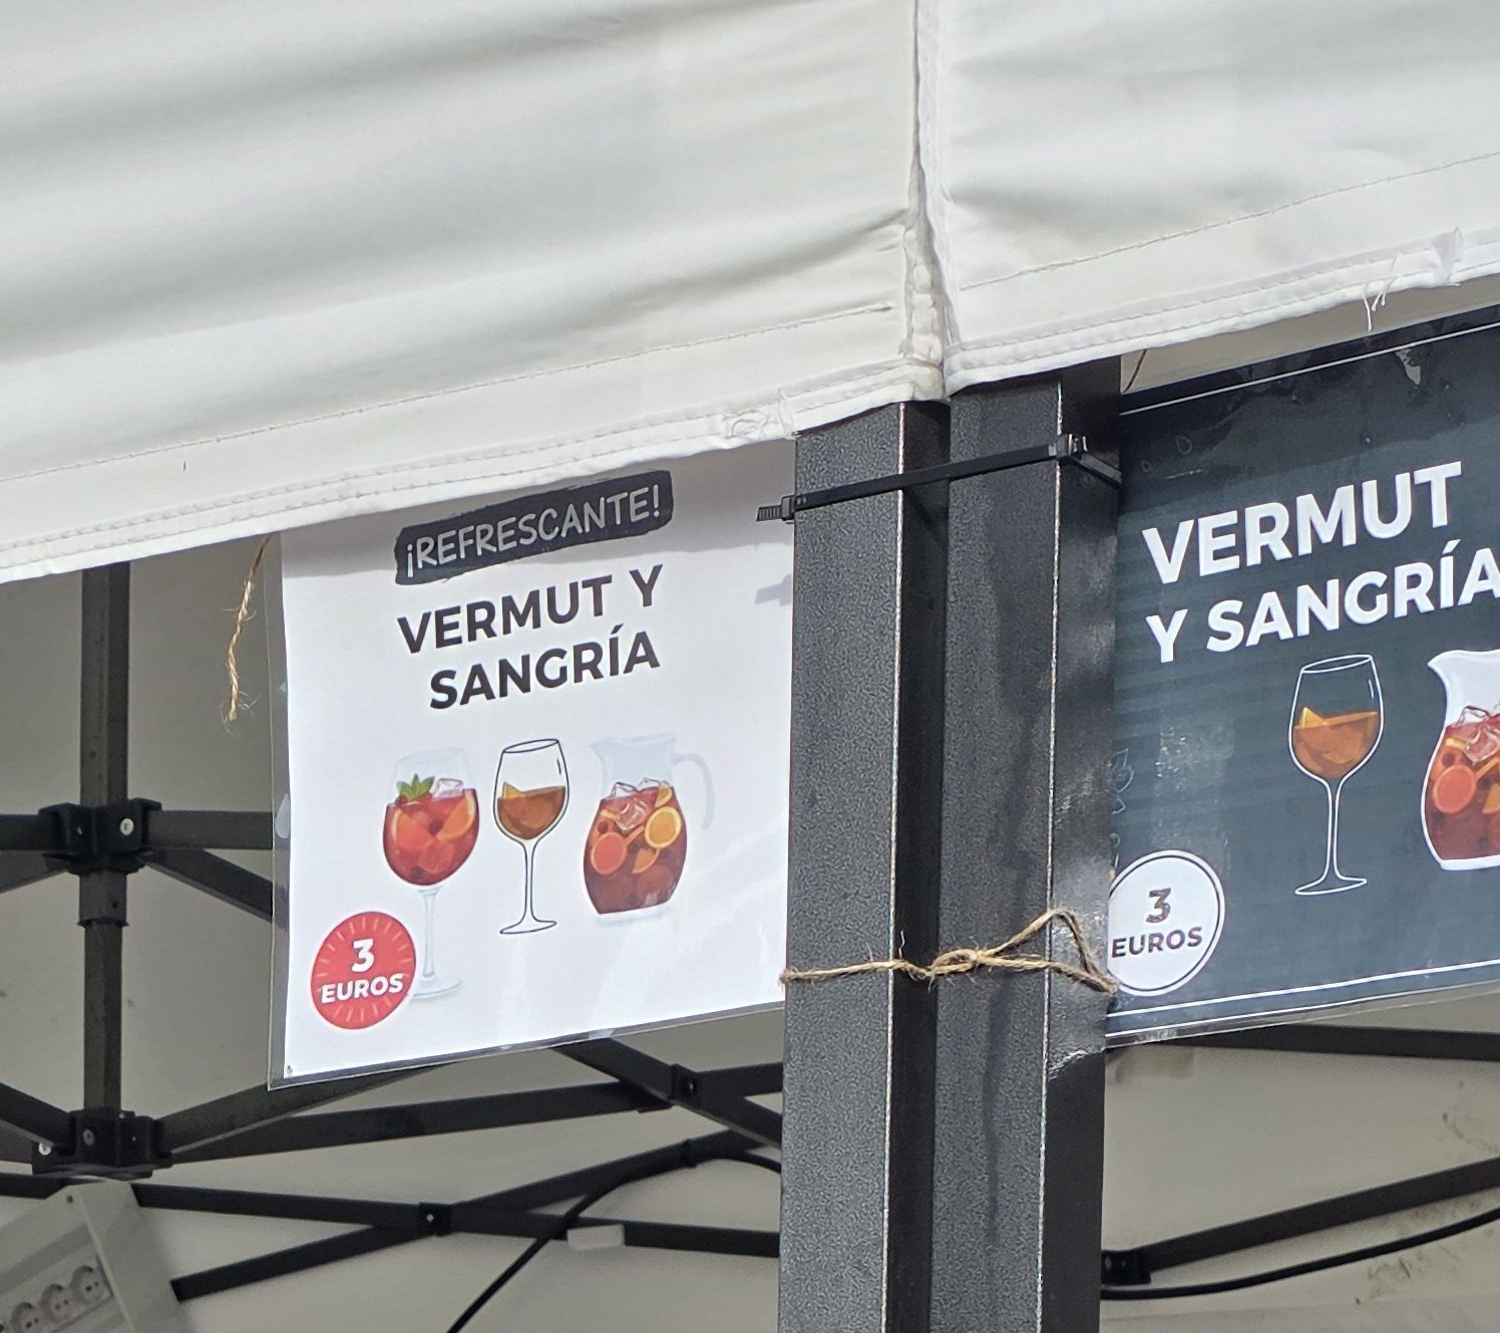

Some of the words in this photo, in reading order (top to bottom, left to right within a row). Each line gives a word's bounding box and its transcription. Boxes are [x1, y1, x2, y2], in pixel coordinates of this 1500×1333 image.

[405, 485, 662, 578] ¡REFRESCANTE!
[1142, 461, 1462, 584] VERMUT
[397, 575, 614, 654] VERMUT
[629, 564, 665, 607] Y
[1145, 609, 1188, 663] Y
[1206, 538, 1500, 653] SANGRÍA
[428, 631, 661, 711] SANGRÍA
[1110, 926, 1204, 960] EUROS
[1145, 887, 1171, 924] 3
[320, 972, 405, 1005] EUROS
[351, 938, 375, 974] 3
